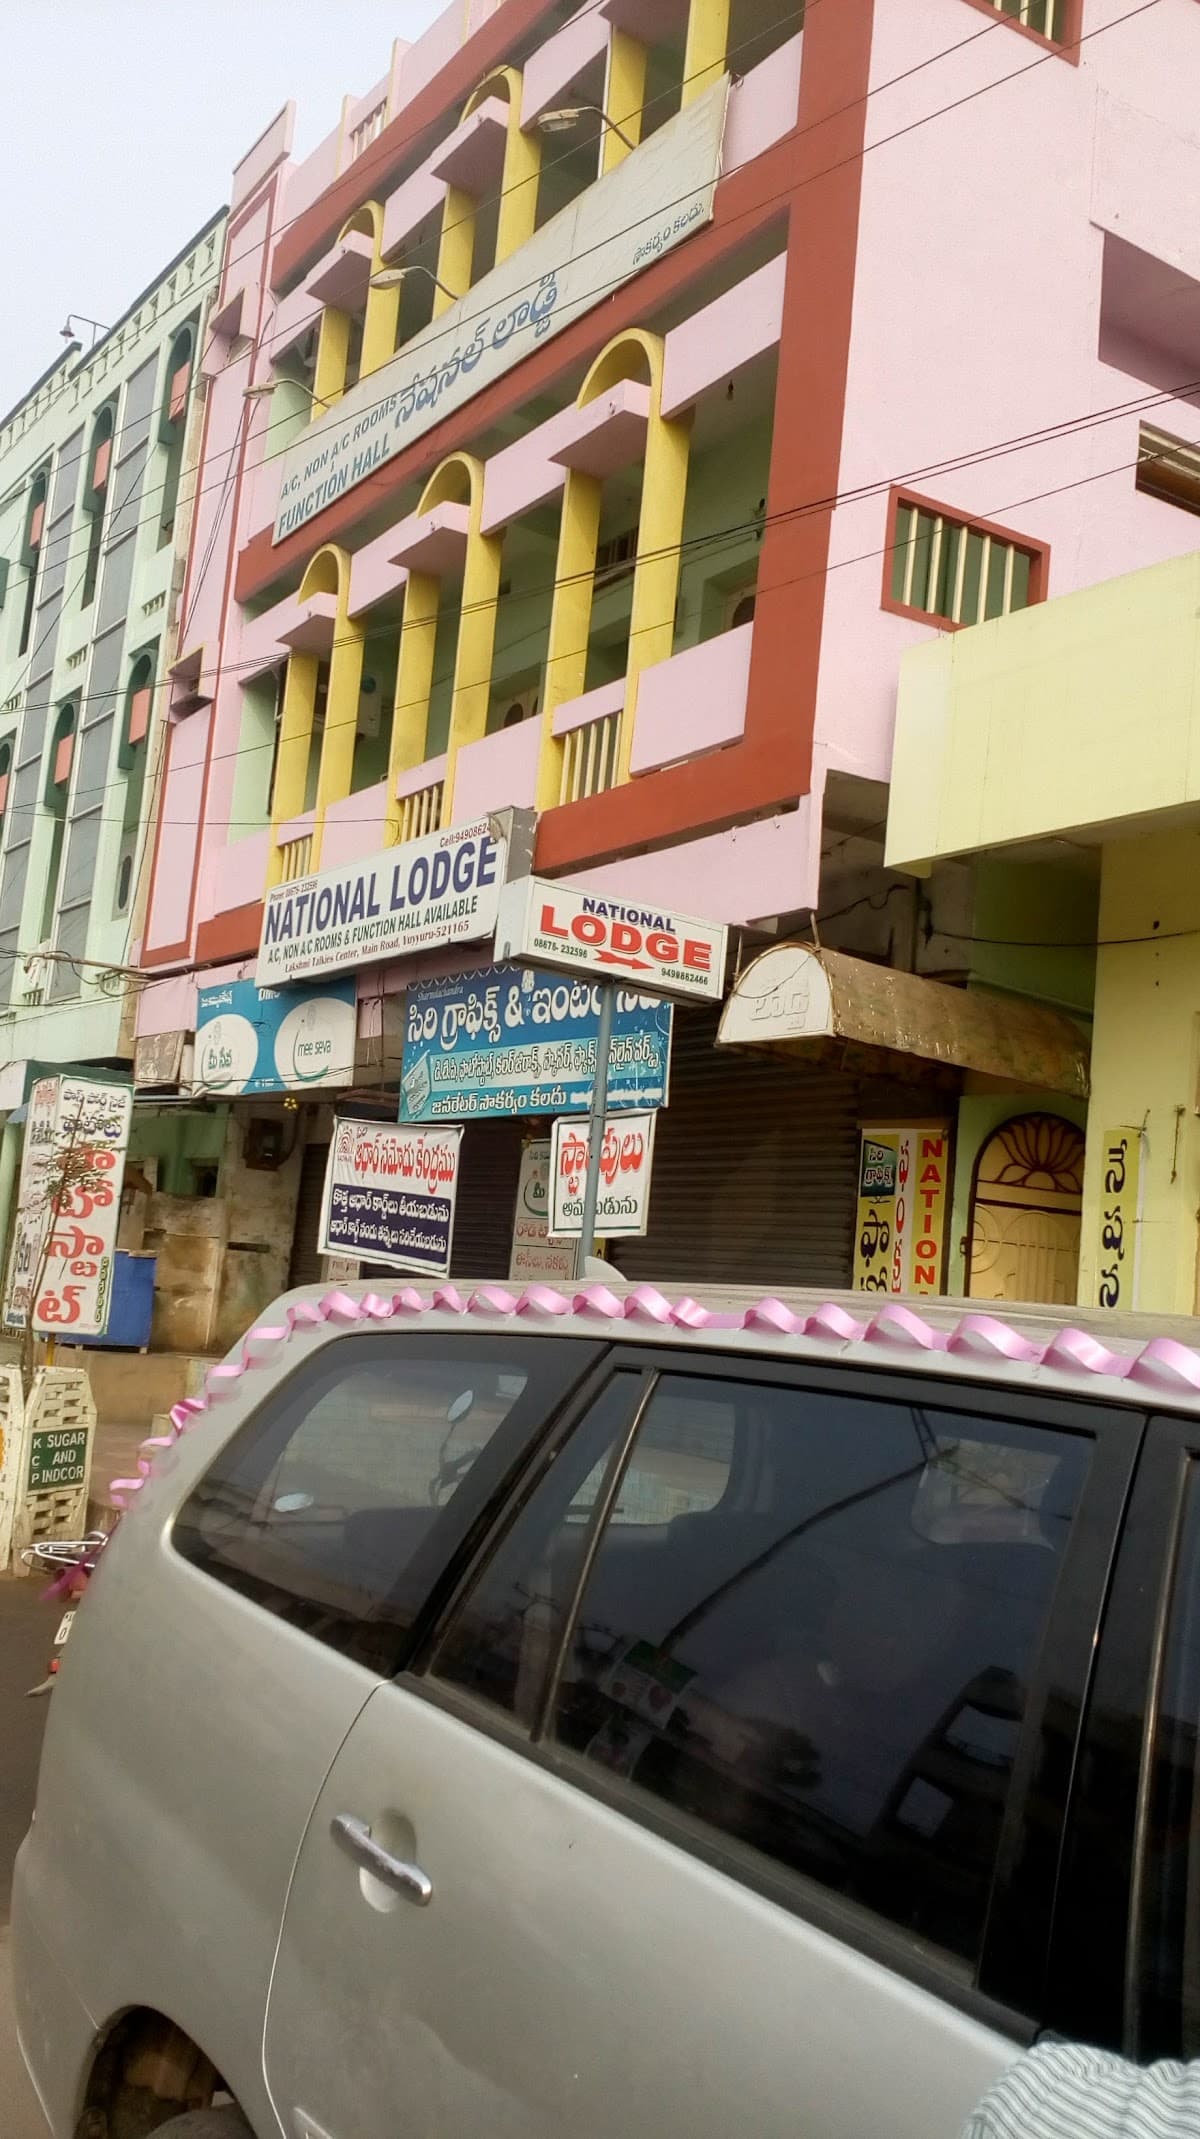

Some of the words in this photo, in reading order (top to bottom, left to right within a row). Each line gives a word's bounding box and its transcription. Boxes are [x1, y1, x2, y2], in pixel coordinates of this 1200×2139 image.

[304, 449, 329, 481] NON
[331, 432, 350, 460] A/C
[353, 397, 397, 442] ROOMS
[278, 464, 348, 538] FUNCTION
[351, 433, 390, 481] HALL
[264, 872, 381, 945] NATIONAL
[389, 835, 498, 911] LODGE
[582, 897, 676, 933] NATIONAL
[283, 944, 299, 961] NON
[314, 931, 343, 953] ROOMS
[352, 917, 397, 943] FUNCTION
[398, 910, 422, 932] HALL
[424, 895, 478, 926] AVAILABLE
[540, 904, 713, 973] LODGE
[407, 1004, 438, 1043] సిరి
[504, 985, 525, 1028] &
[298, 1042, 314, 1058] mee
[314, 1039, 332, 1056] seva
[529, 1084, 567, 1107] కలదు
[914, 1138, 944, 1295] NATION
[32, 1455, 40, 1467] C
[52, 1450, 76, 1466] AND
[33, 1438, 42, 1449] K
[47, 1431, 86, 1449] SUGAR
[32, 1474, 40, 1484] P
[42, 1465, 84, 1483] INDCOR
